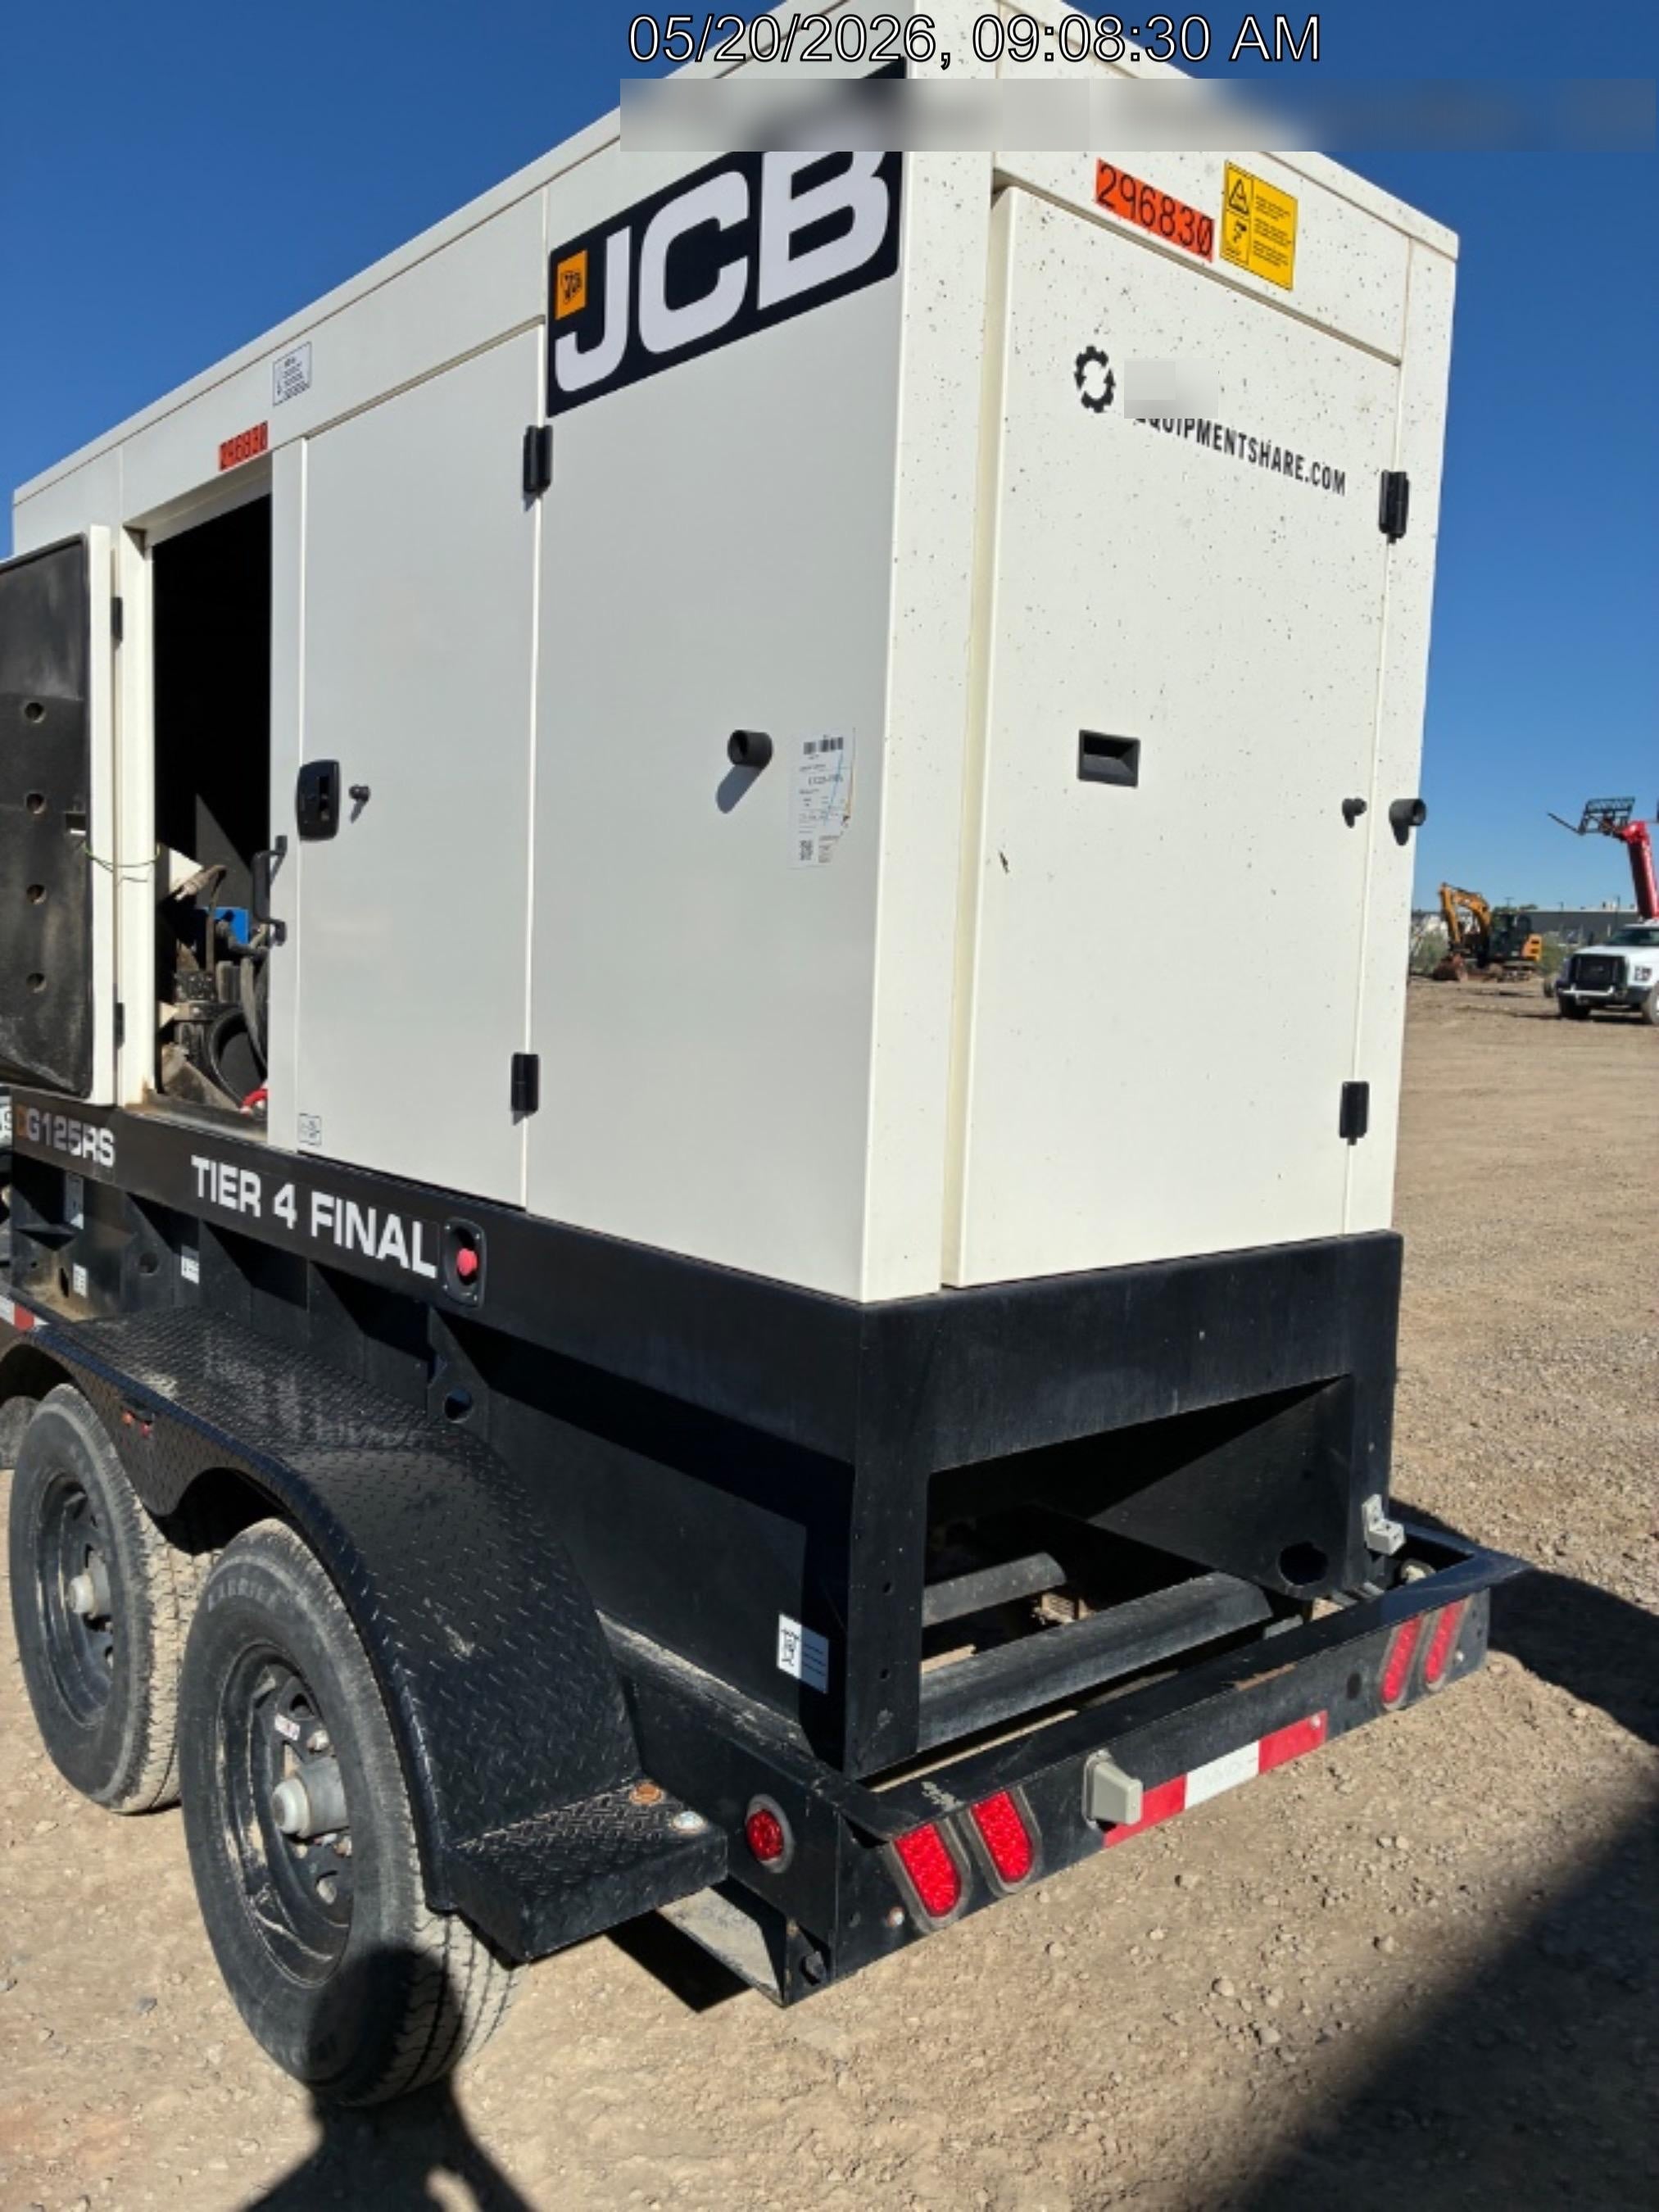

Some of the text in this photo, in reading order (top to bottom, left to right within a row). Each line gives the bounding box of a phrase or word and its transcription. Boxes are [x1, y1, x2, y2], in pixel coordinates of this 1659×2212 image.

[1096, 163, 1213, 256] 296830
[555, 151, 891, 392] JCB
[1133, 418, 1346, 496] UIPMENTSHARE.COM
[191, 1155, 437, 1280] TIER 4 FINAL
